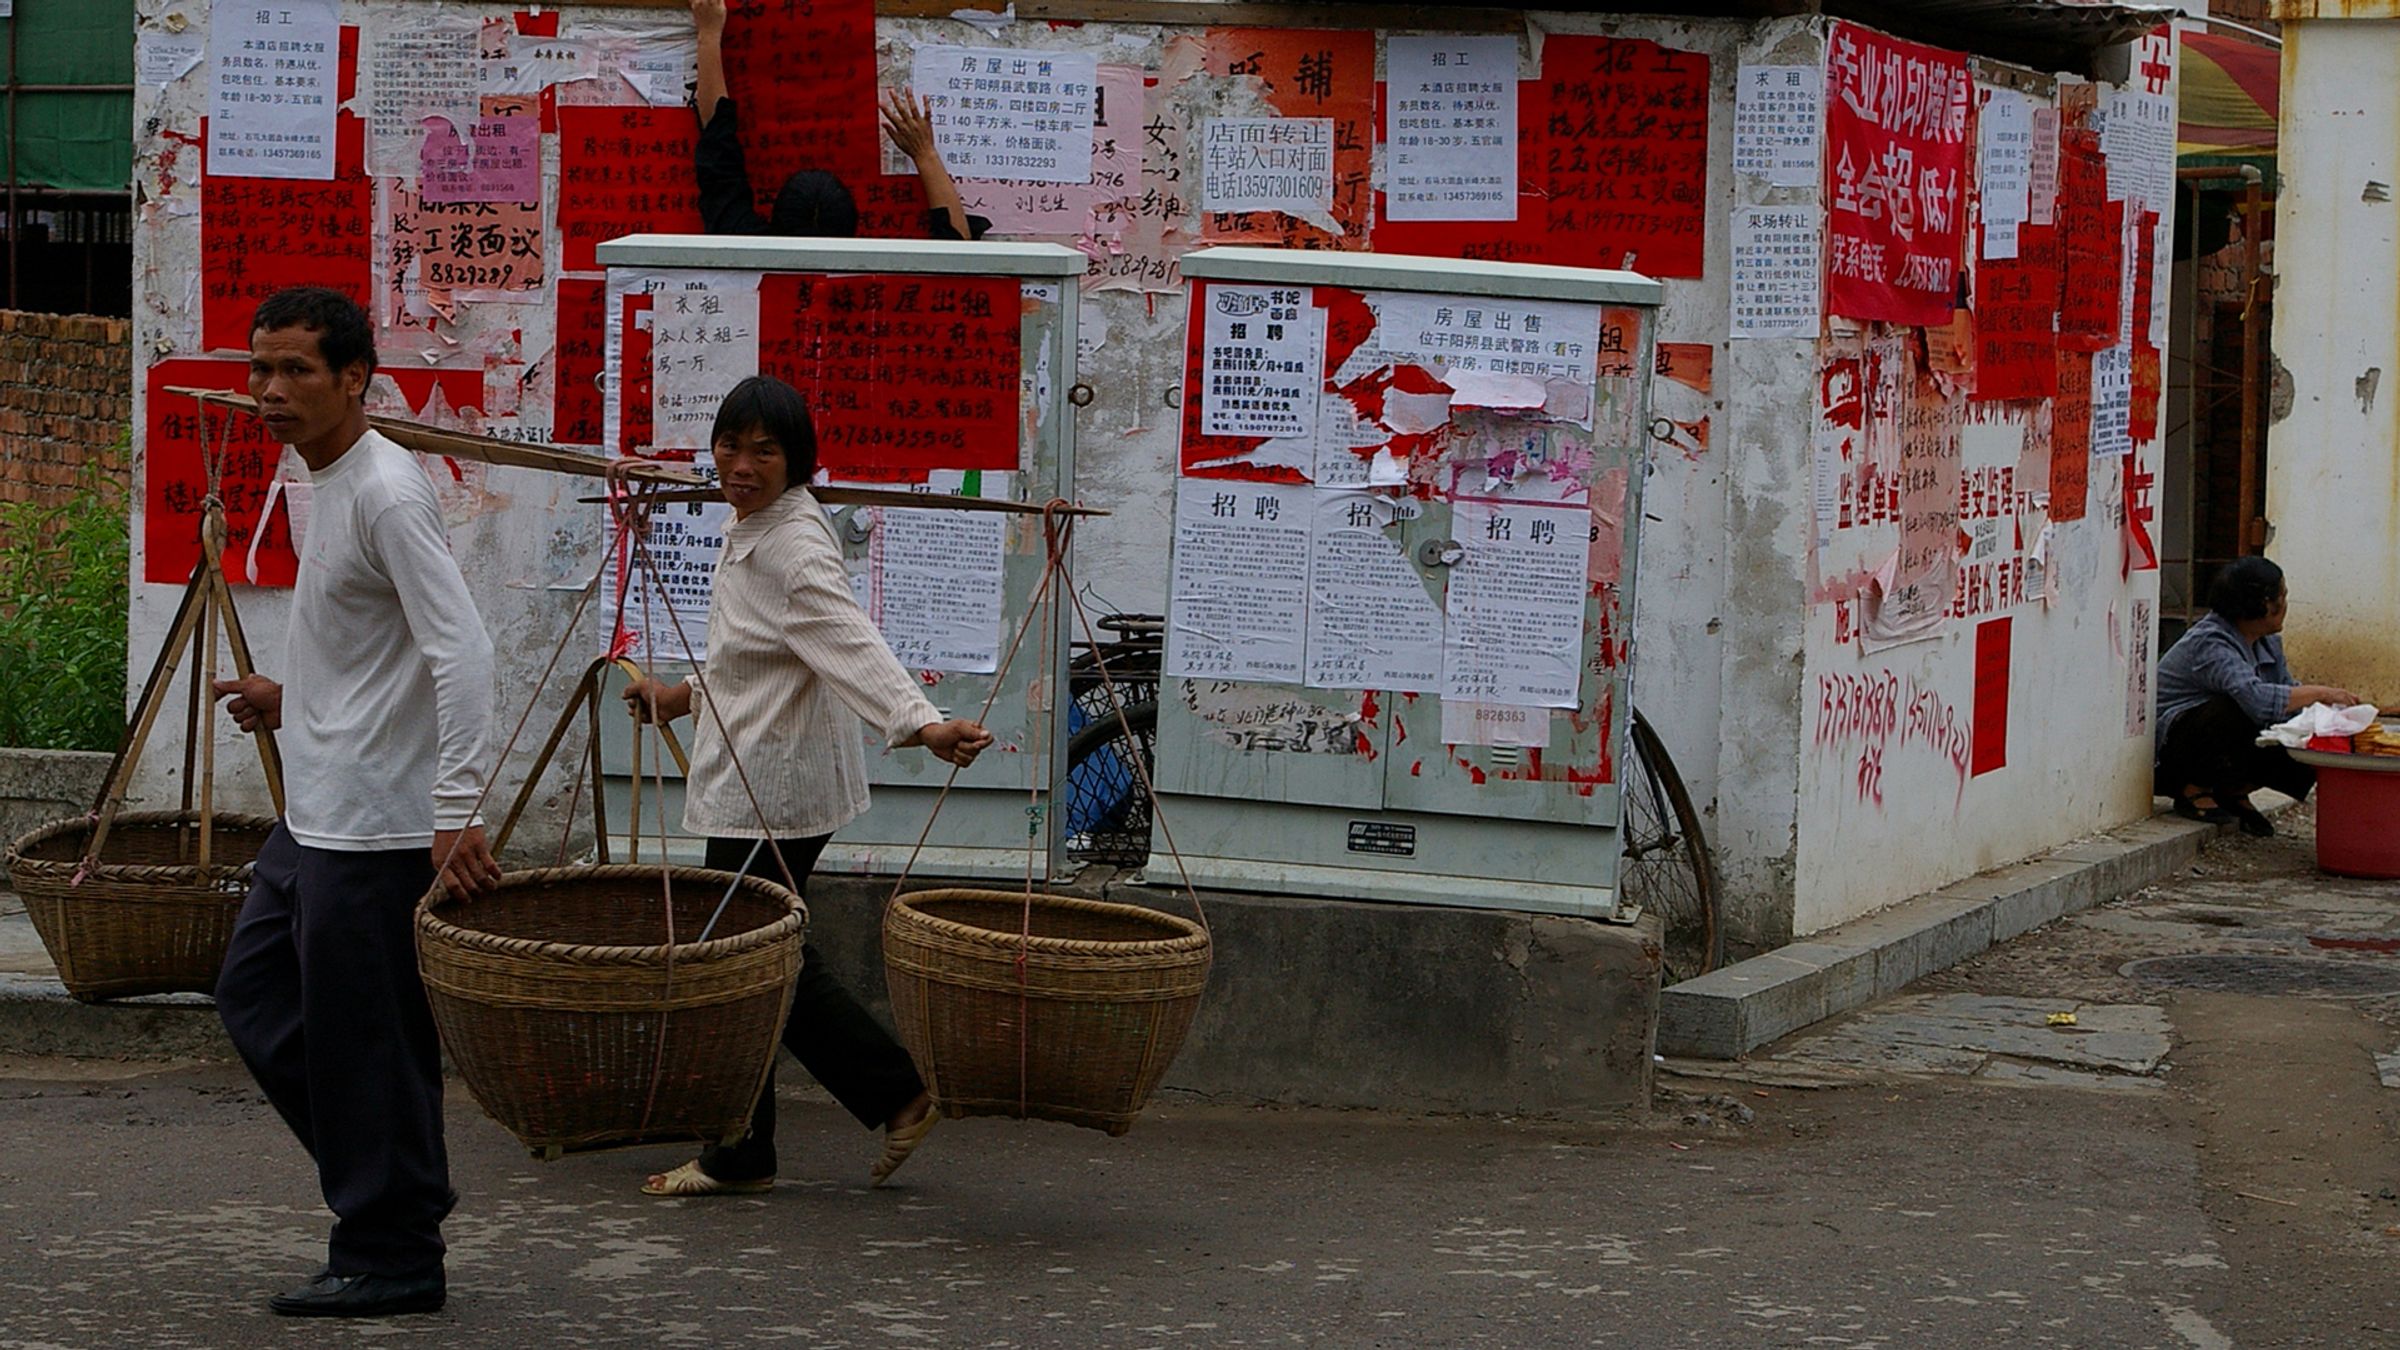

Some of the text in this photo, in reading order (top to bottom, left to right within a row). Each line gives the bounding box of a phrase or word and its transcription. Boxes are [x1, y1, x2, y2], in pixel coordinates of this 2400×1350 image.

[256, 10, 293, 25] 招工
[243, 40, 325, 53] 本酒店招聘女服
[960, 56, 1053, 78] 房屋出售
[1431, 52, 1470, 67] 招工
[1593, 39, 1688, 77] 招工
[1419, 82, 1503, 94] 本酒店招聘女服
[1755, 72, 1801, 87] 求租
[1208, 122, 1327, 145] 店面转让
[1207, 144, 1328, 172] 车站入口对面
[1206, 171, 1323, 200] 电话13597301609
[1015, 193, 1070, 213] 刘先生
[1748, 213, 1809, 229] 果场转让
[423, 222, 541, 260] 工资面议
[430, 262, 513, 289] 8829289
[1270, 290, 1301, 305] 书吧
[1434, 307, 1543, 334] 房屋出售
[1230, 322, 1283, 341] 招聘
[1212, 492, 1281, 521] 招聘
[1486, 516, 1556, 545] 招聘
[1475, 708, 1527, 722] 8826363
